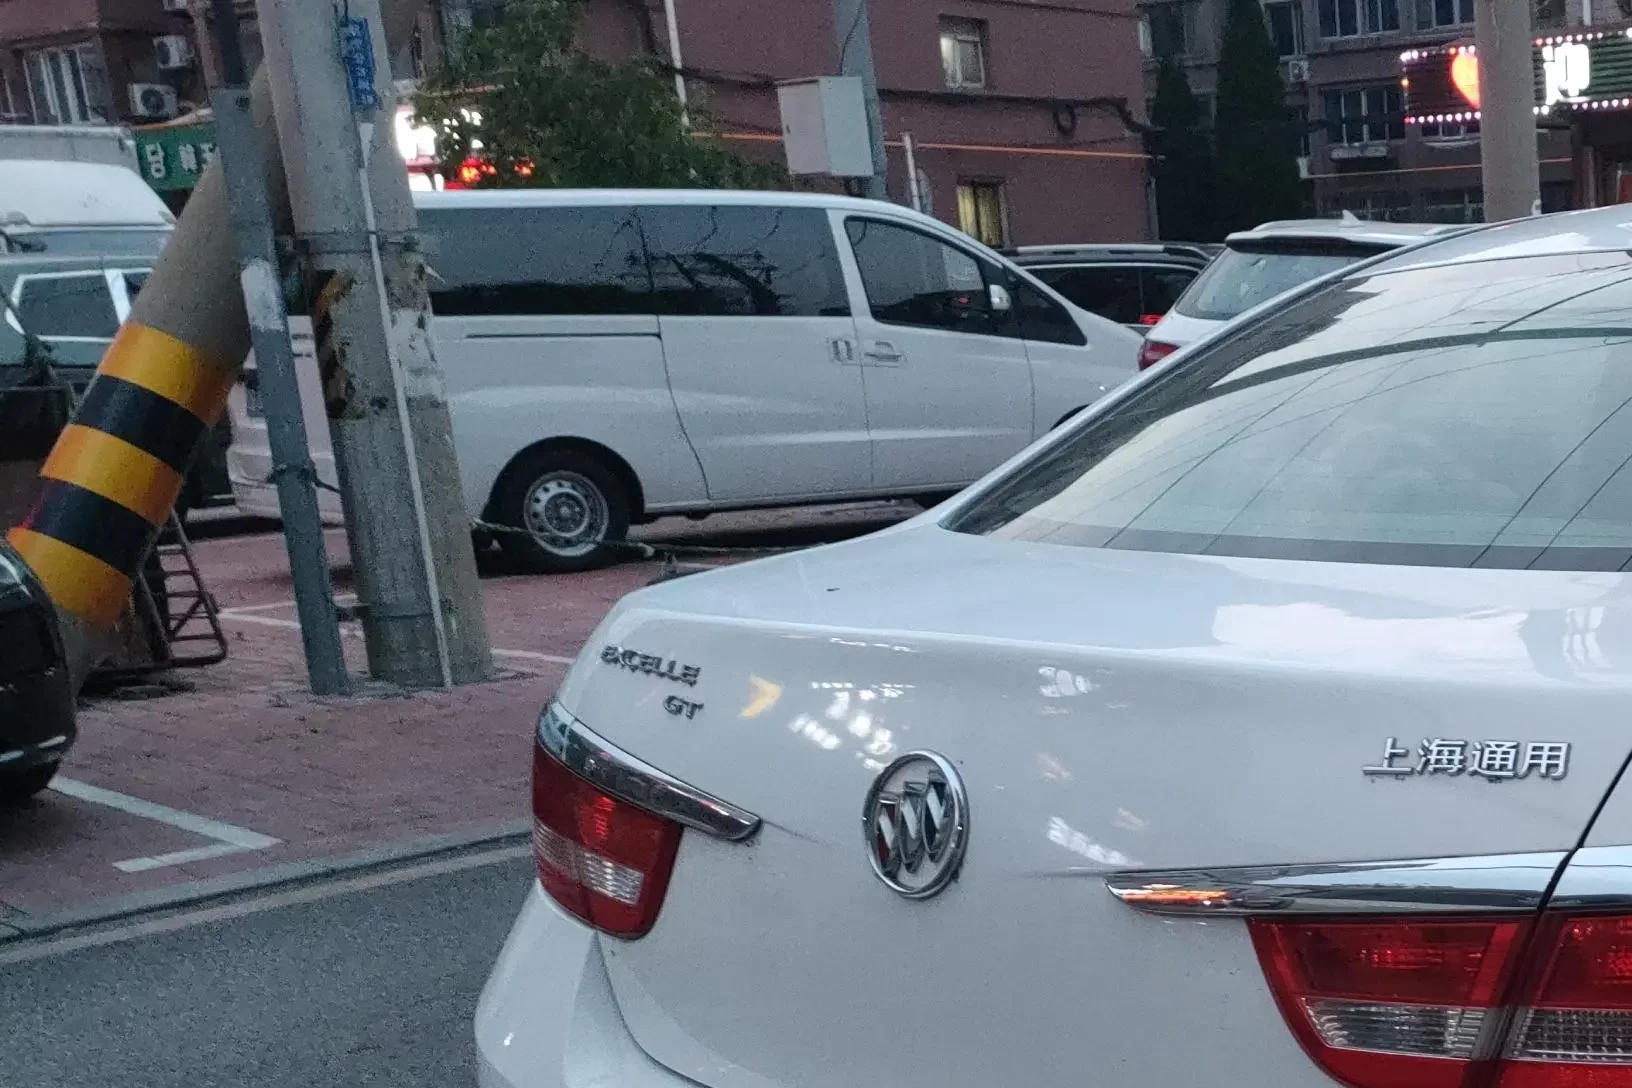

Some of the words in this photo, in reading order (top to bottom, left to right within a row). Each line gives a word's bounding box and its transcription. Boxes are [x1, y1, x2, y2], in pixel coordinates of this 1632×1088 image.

[600, 645, 702, 686] EXCELLE
[663, 695, 705, 720] GT
[1362, 737, 1572, 781] 上海通用
